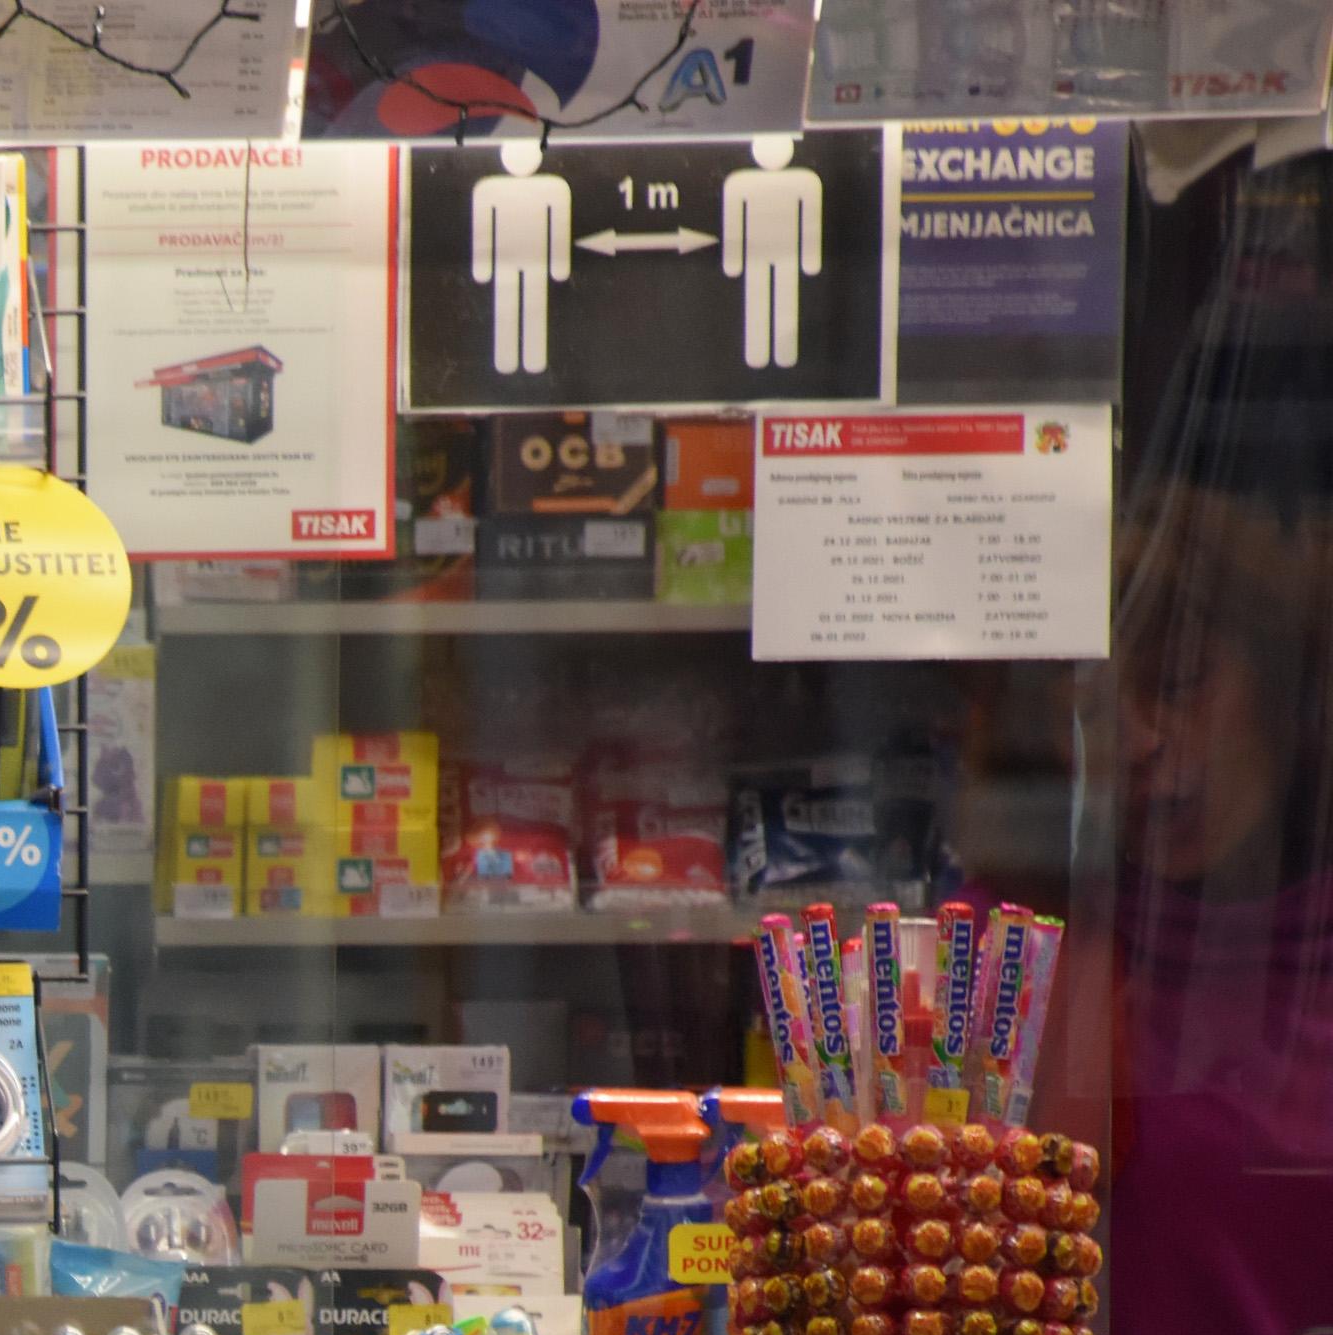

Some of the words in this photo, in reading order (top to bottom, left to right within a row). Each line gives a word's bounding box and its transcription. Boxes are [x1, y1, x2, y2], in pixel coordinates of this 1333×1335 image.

[900, 146, 1095, 181] EXCHANGE
[618, 175, 634, 210] 1
[646, 182, 680, 210] m
[900, 204, 1095, 239] MJENJAČNICA
[770, 423, 844, 450] TISAK
[298, 514, 369, 537] TISAK
[758, 933, 794, 1066] mentos
[809, 920, 847, 1057] mentos
[871, 920, 902, 1057] mentos
[945, 920, 974, 1057] mentos
[989, 924, 1027, 1059] mentos
[354, 1240, 389, 1255] CARD
[692, 1235, 736, 1252] SUP
[320, 1271, 342, 1284] AA
[682, 1257, 729, 1273] PON
[179, 1308, 242, 1325] DURAC
[319, 1308, 391, 1325] DURACE
